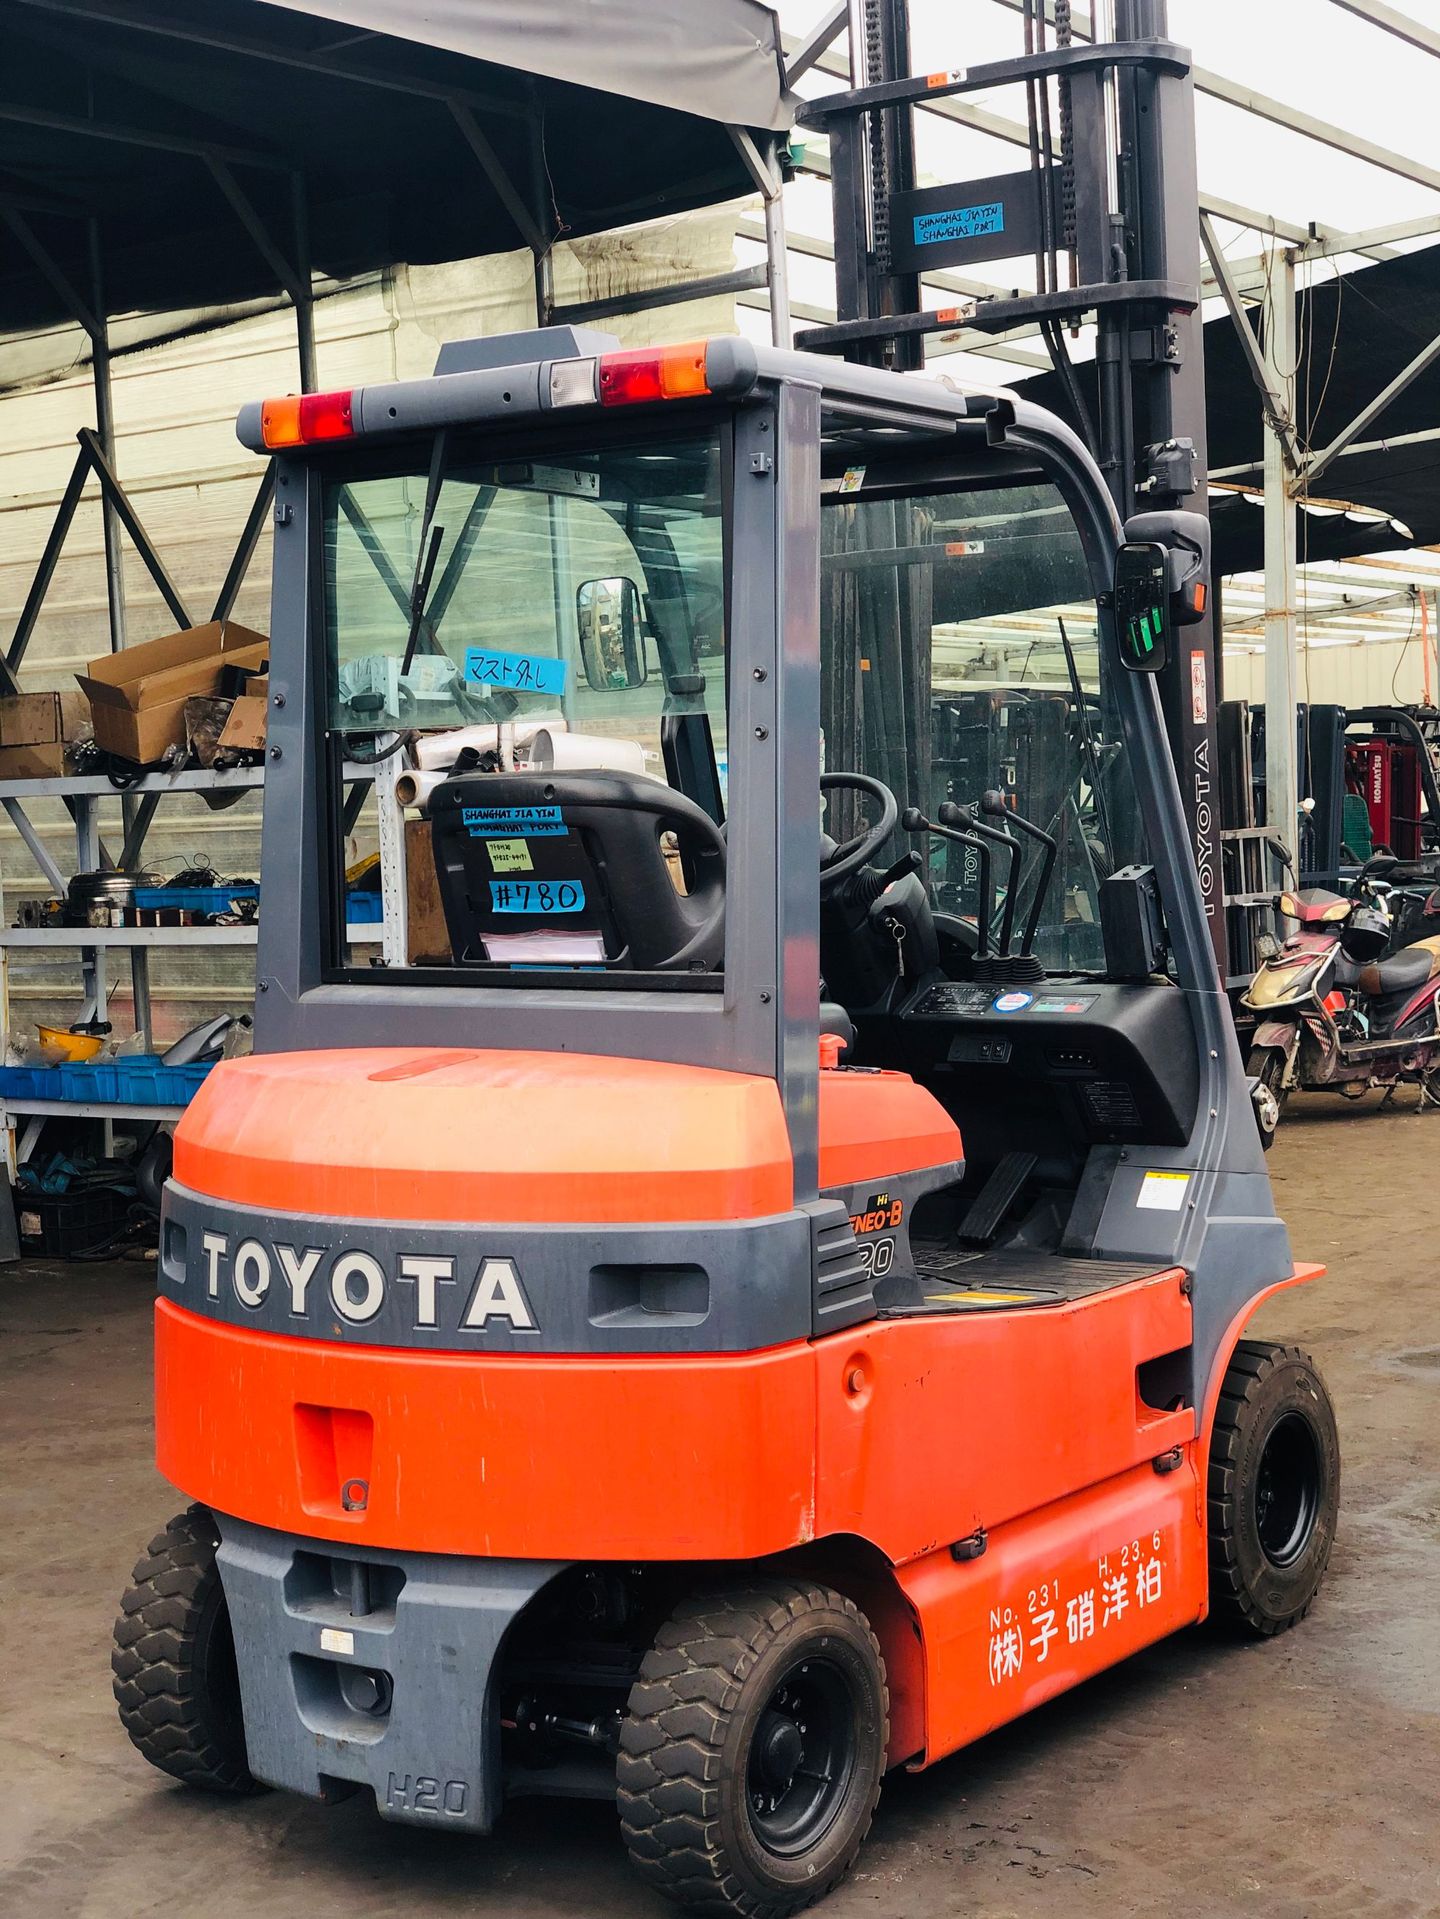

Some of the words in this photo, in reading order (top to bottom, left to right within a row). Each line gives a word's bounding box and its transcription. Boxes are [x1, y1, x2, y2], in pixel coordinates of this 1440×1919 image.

[919, 213, 962, 230] SHANGHAI
[923, 225, 969, 242] SHANGHAI
[974, 220, 994, 236] PORT
[470, 656, 546, 688] マスト外し
[1372, 755, 1382, 804] KOMATSU
[465, 809, 511, 820] SHANGHAI
[514, 809, 533, 819] JIA
[535, 808, 555, 818] YIN
[964, 801, 979, 884] TOYOA
[495, 883, 577, 911] #780
[877, 1194, 888, 1206] Hi
[202, 1231, 537, 1330] TOYOTA
[989, 1606, 1018, 1632] No.
[1027, 1578, 1060, 1612] 231
[386, 1771, 470, 1817] H20
